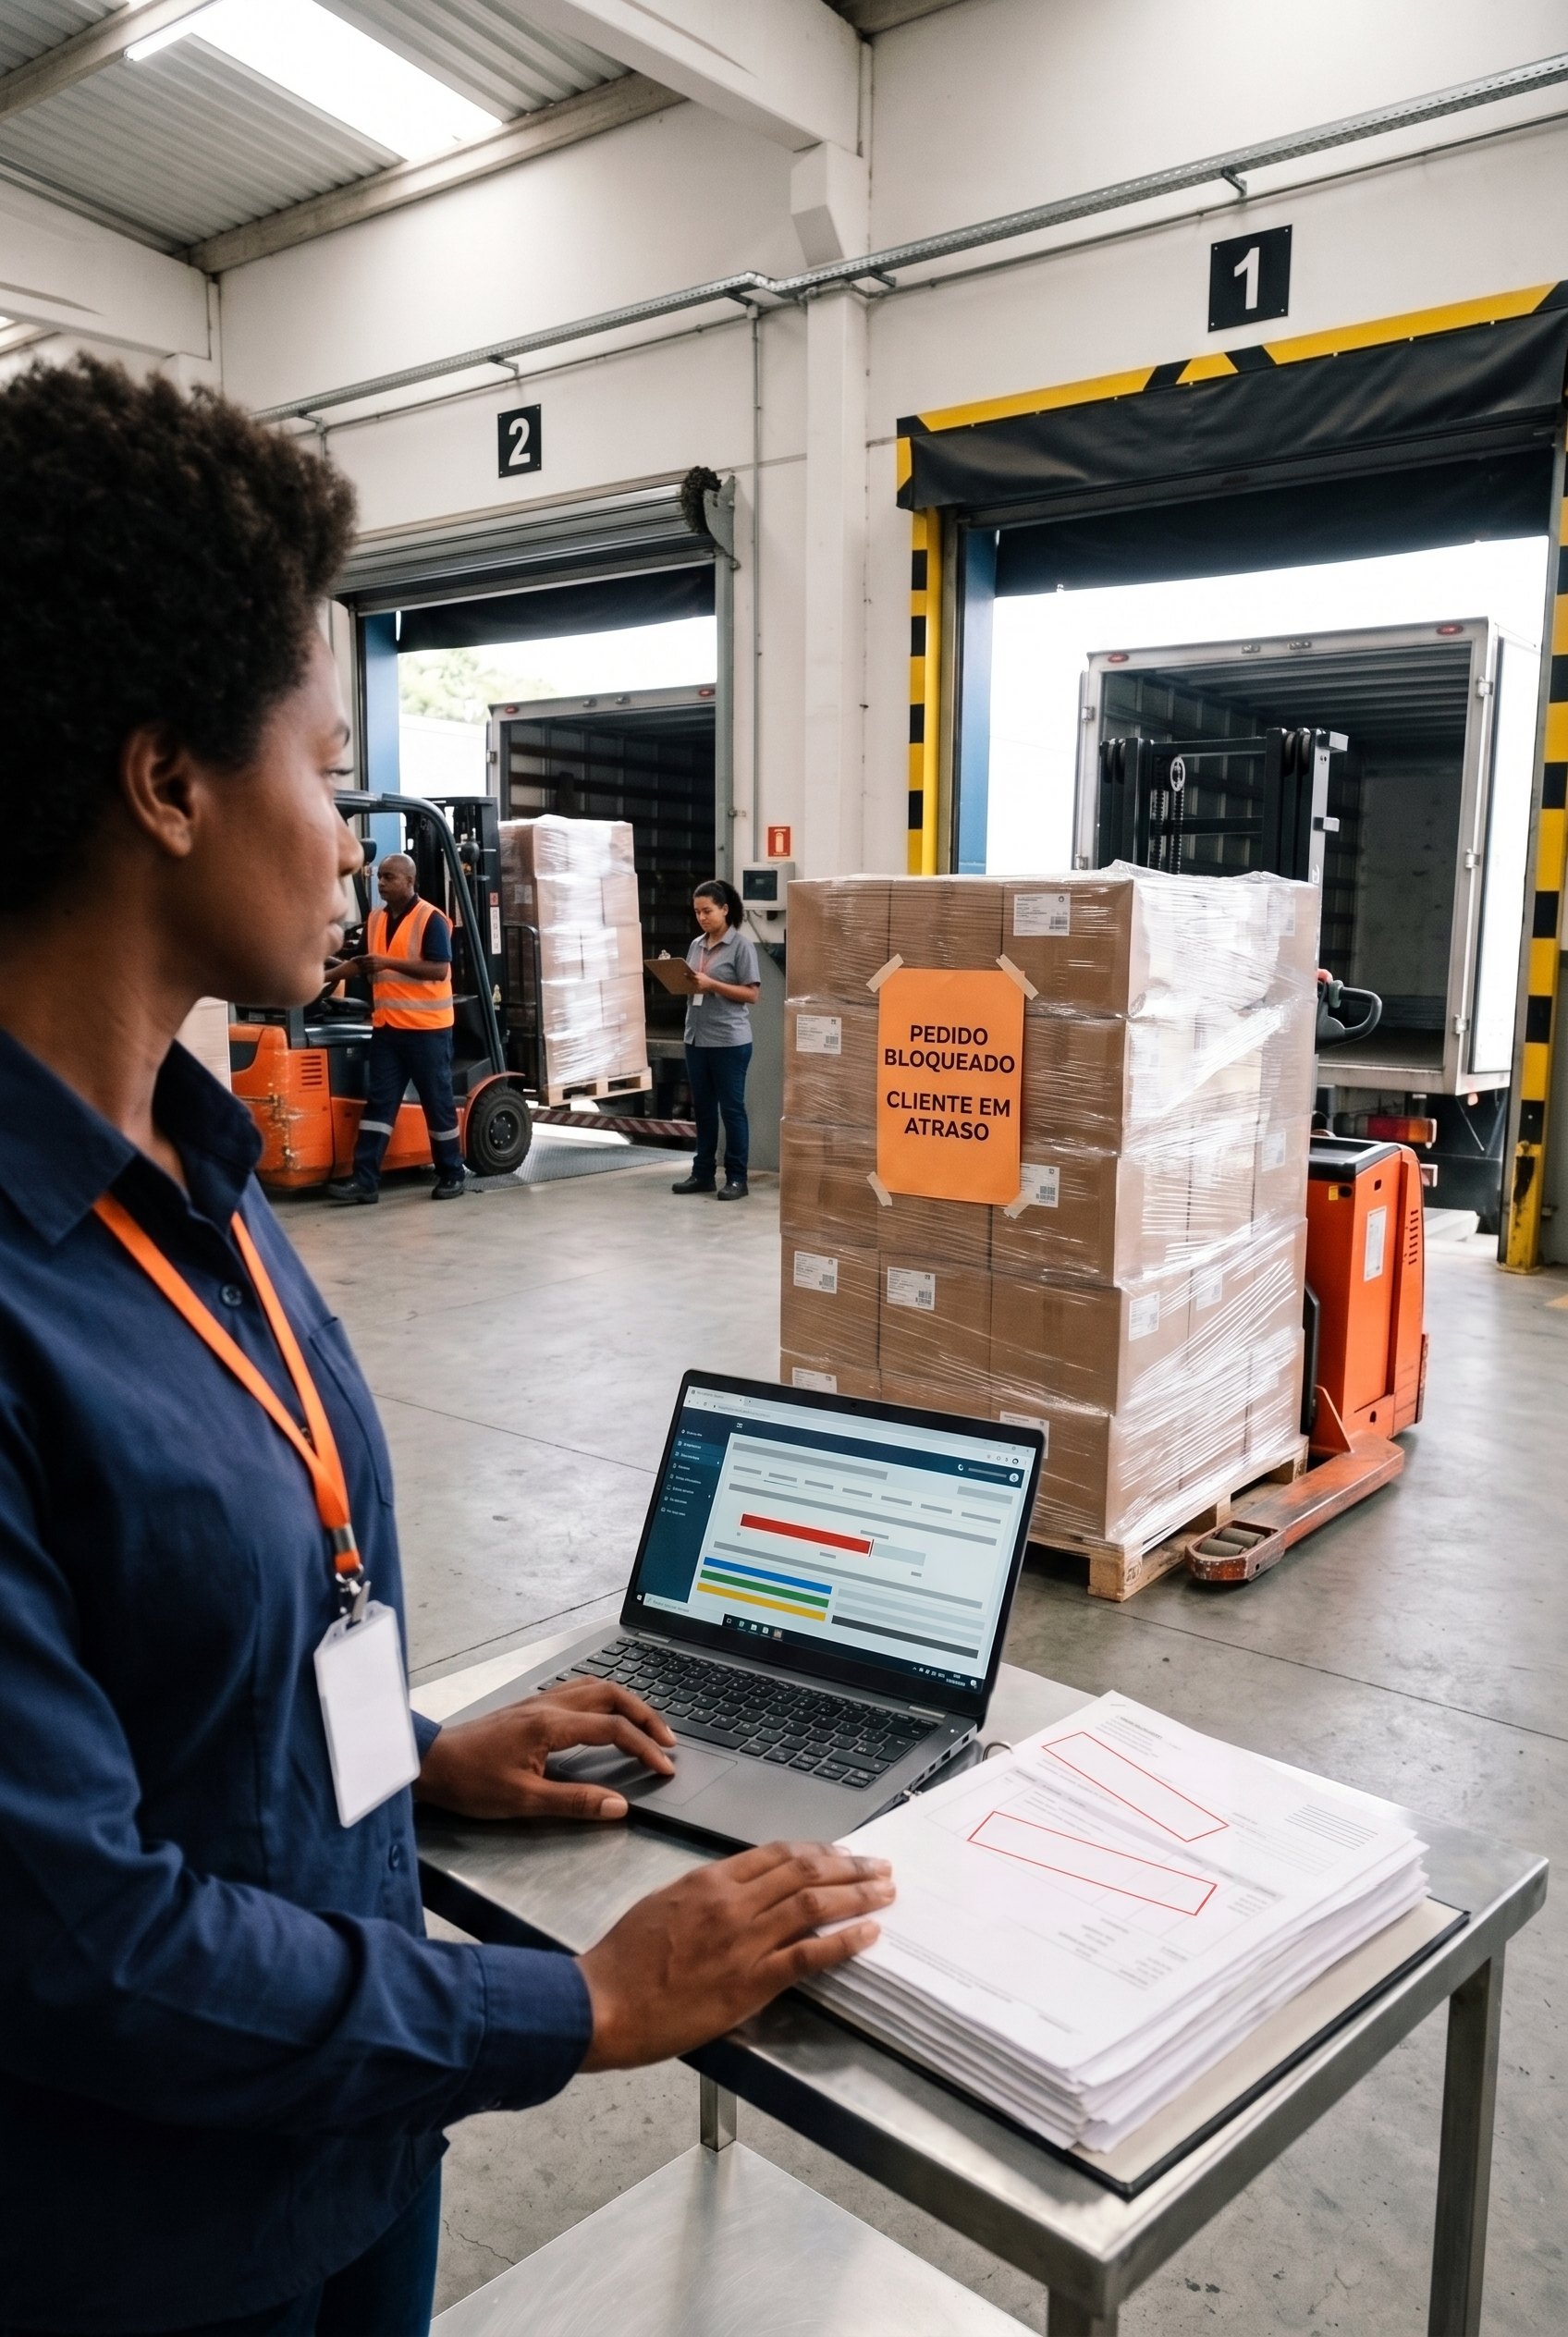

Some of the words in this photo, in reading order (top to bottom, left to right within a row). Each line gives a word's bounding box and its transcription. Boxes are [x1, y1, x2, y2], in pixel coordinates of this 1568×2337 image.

[1233, 246, 1260, 310] 1
[508, 417, 531, 467] 2
[910, 1024, 988, 1046] PEDIDO
[884, 1048, 1015, 1074] BLOQUEADO
[886, 1090, 973, 1115] CLIENTE
[979, 1096, 1011, 1118] EM
[903, 1117, 989, 1142] ATRASO
